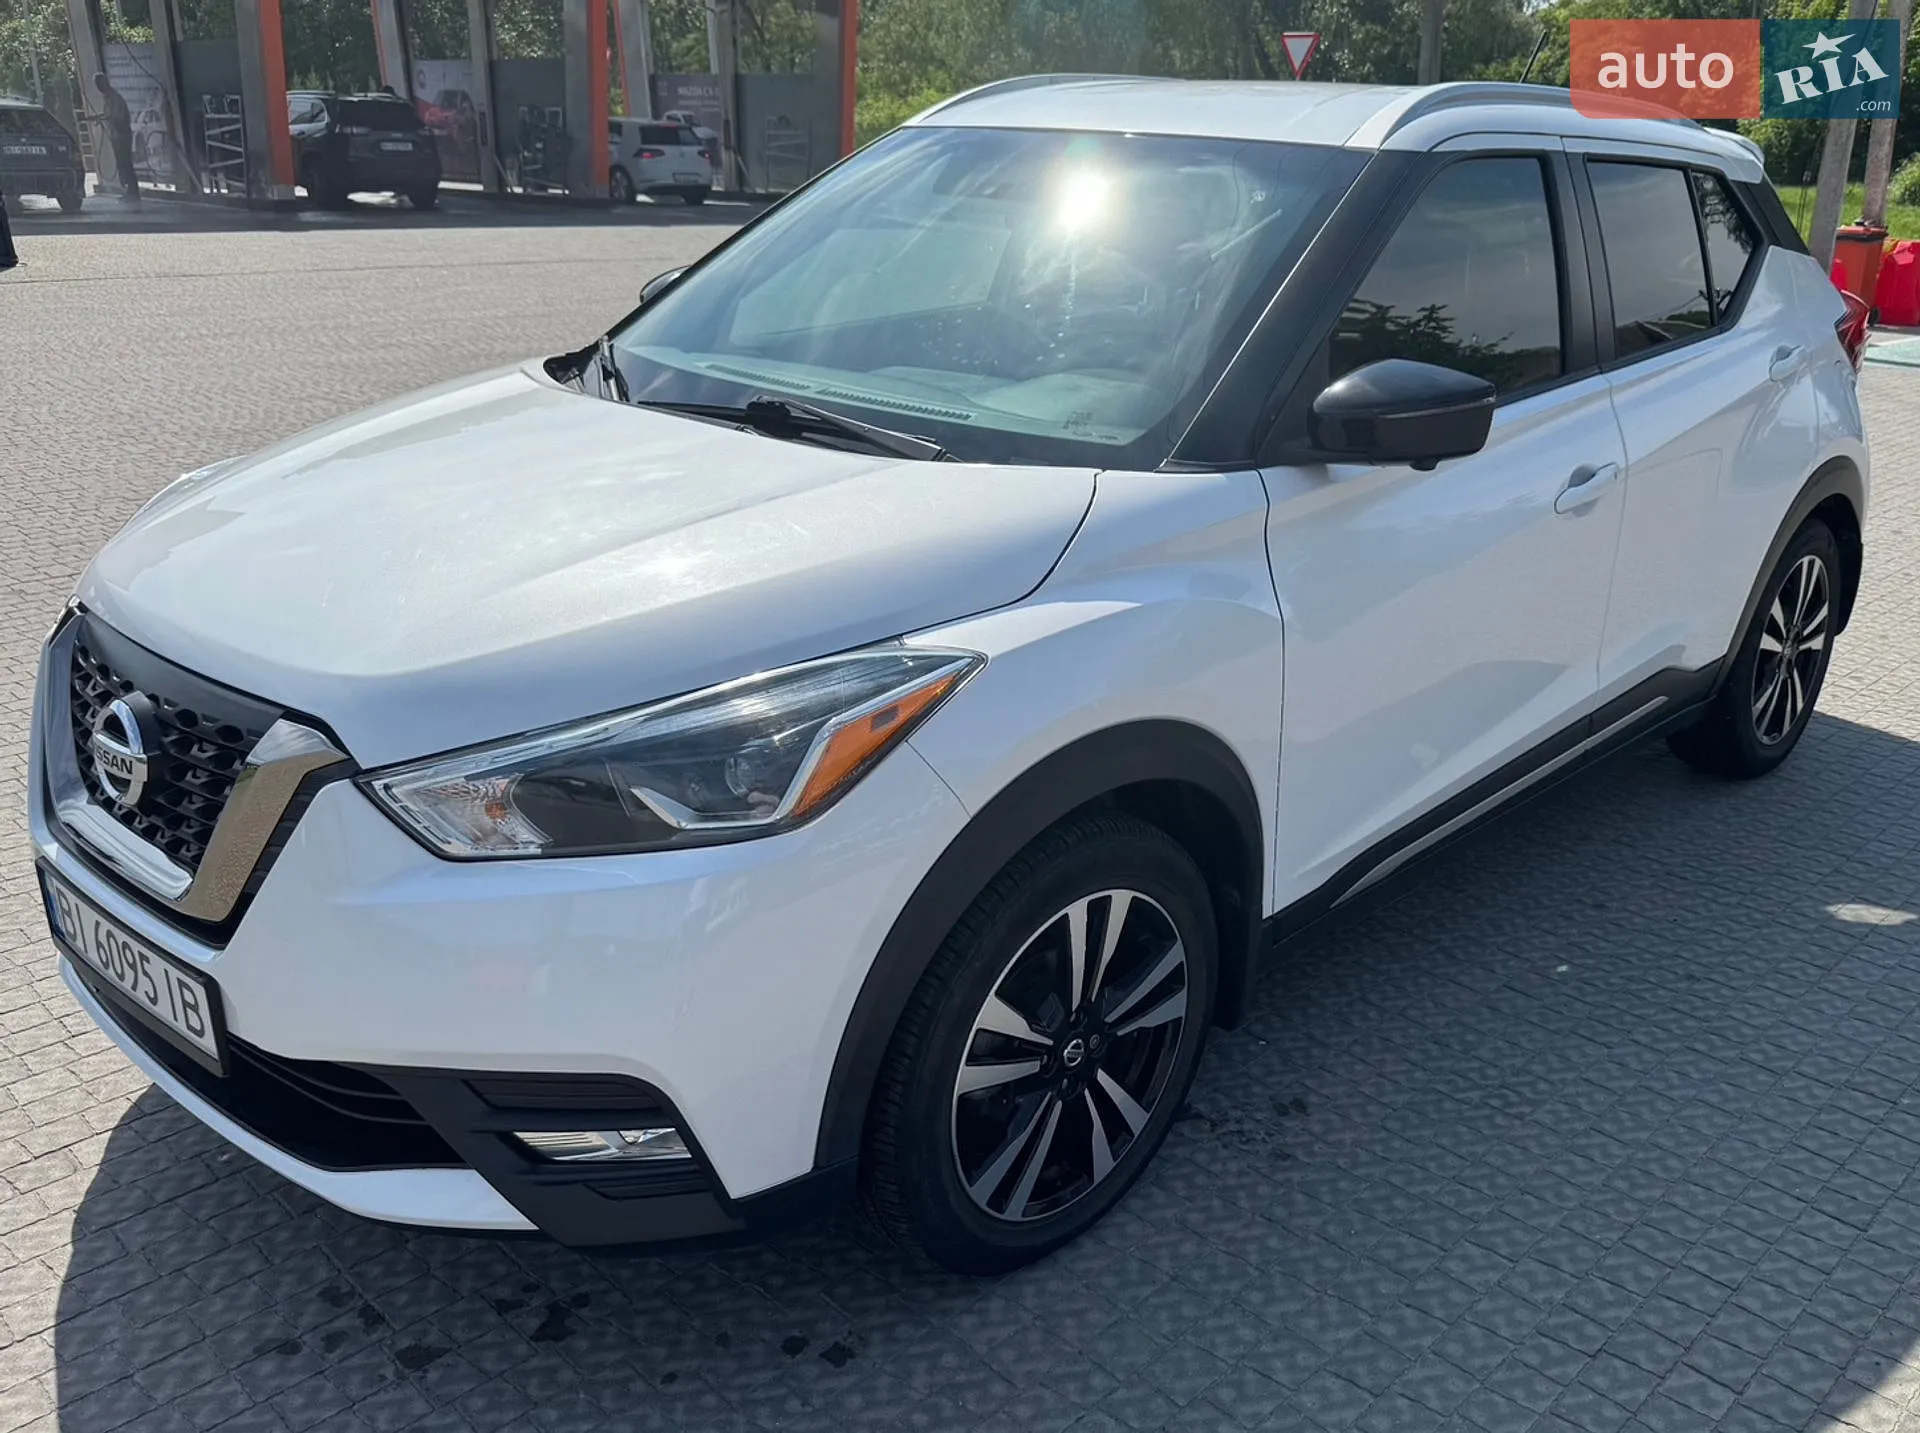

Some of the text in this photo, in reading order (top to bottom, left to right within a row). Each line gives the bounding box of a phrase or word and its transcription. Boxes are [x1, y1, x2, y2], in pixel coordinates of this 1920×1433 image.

[95, 744, 133, 775] SSAN
[56, 886, 205, 1039] BI 6095 IB
